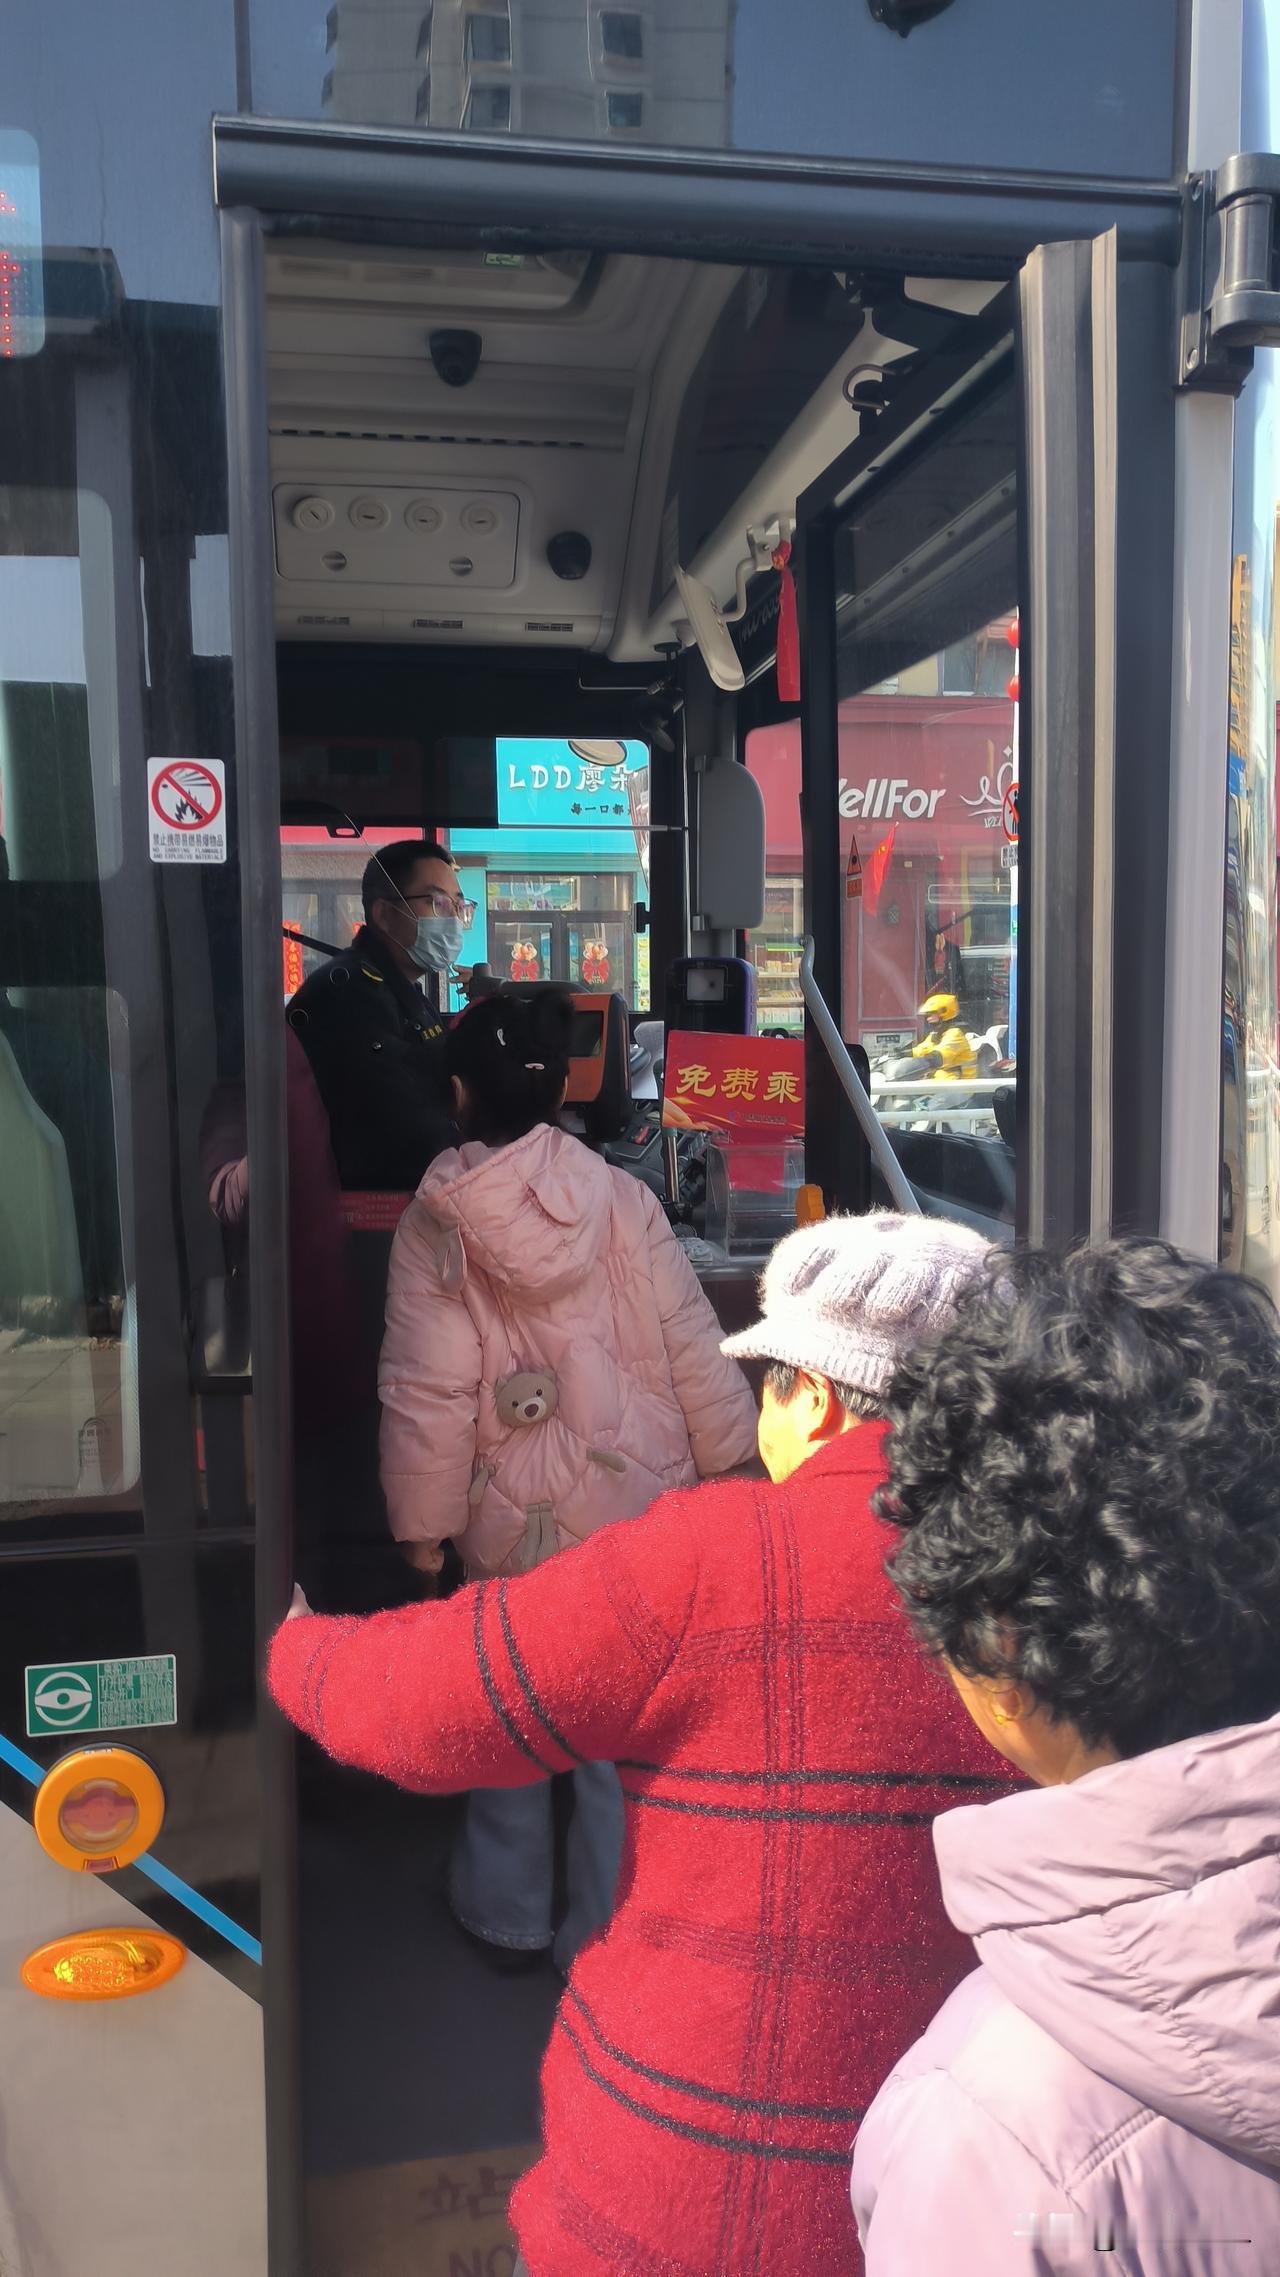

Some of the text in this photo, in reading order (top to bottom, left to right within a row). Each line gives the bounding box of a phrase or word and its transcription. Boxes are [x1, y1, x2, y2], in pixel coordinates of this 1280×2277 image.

[508, 762, 638, 792] LDD廖朵
[571, 802, 631, 816] 每一口都
[675, 1063, 803, 1104] 免费乘
